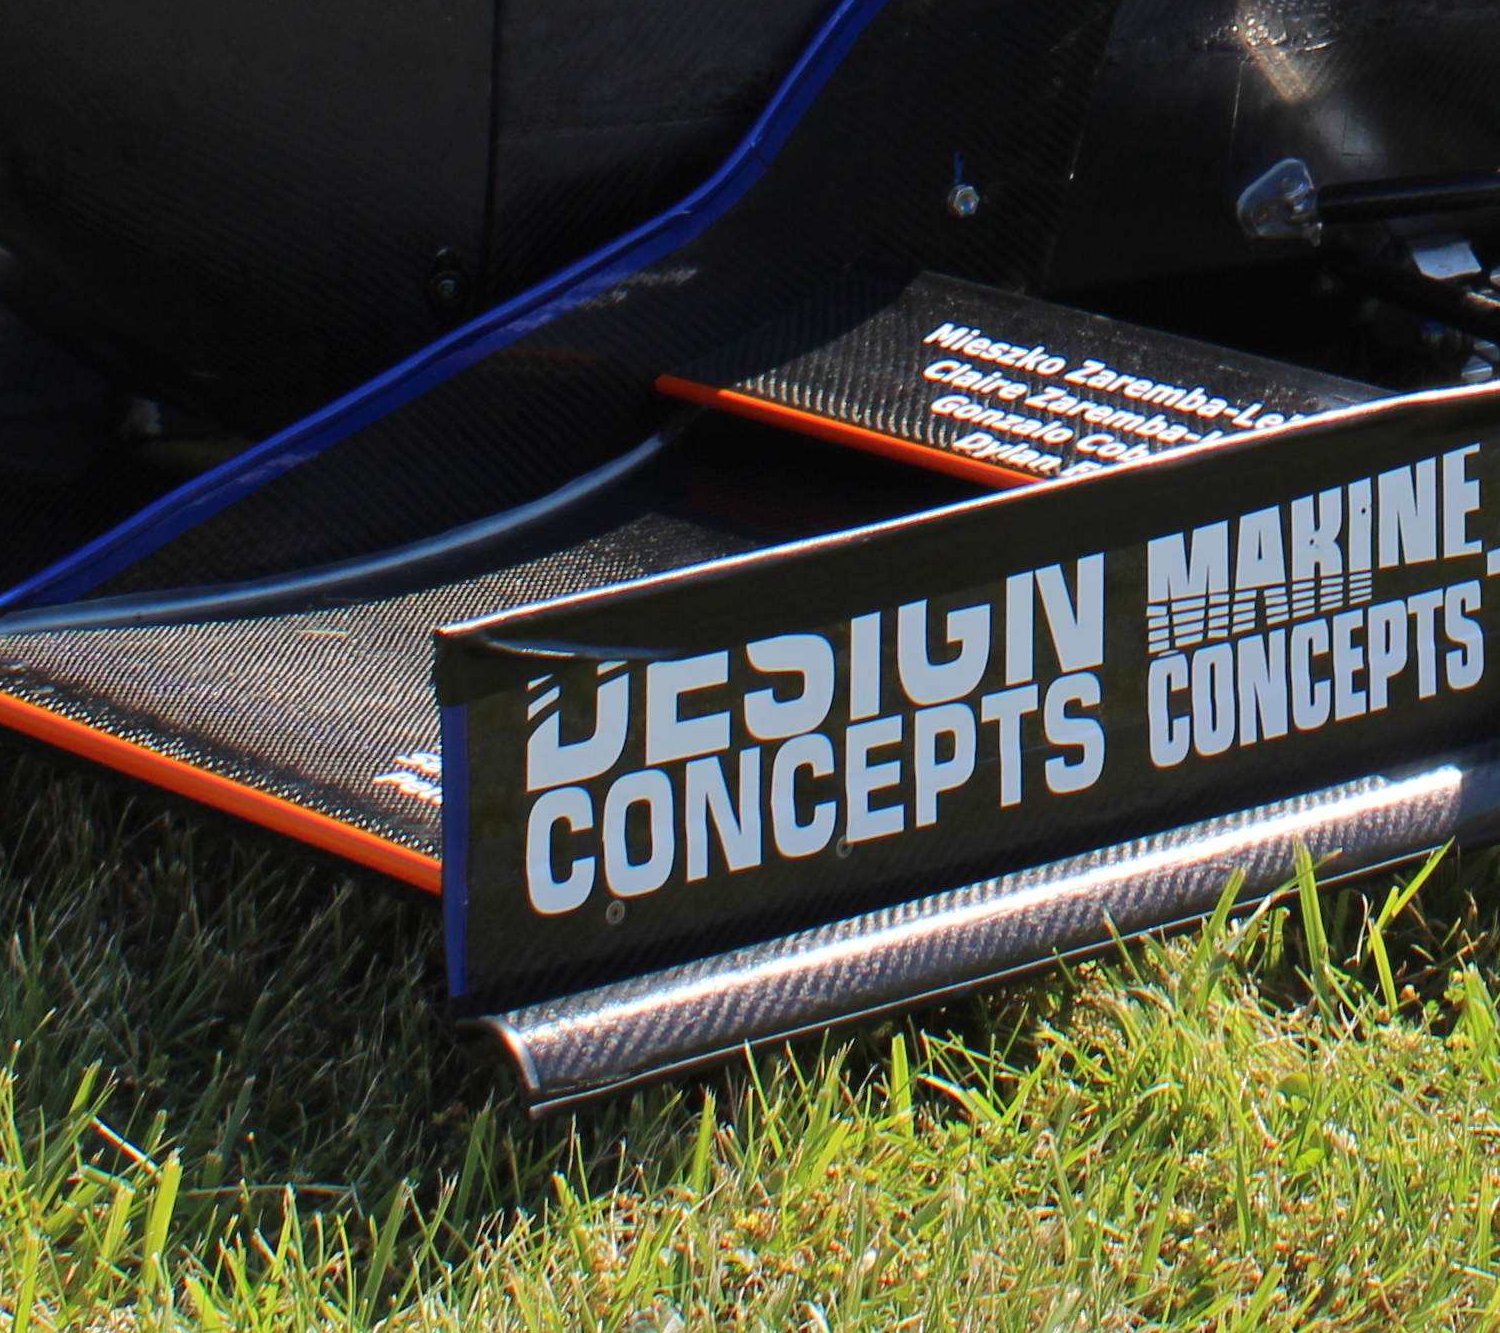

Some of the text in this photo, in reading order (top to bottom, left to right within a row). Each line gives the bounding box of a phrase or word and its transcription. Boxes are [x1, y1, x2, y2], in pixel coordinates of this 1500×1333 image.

[923, 322, 1067, 377] Mieszko
[923, 359, 1027, 402] Claire
[930, 393, 1076, 445] Gonzalo
[952, 430, 1064, 476] Dylan
[1147, 579, 1485, 768] CONCEPTS
[526, 672, 1105, 915] CONCEPTS
